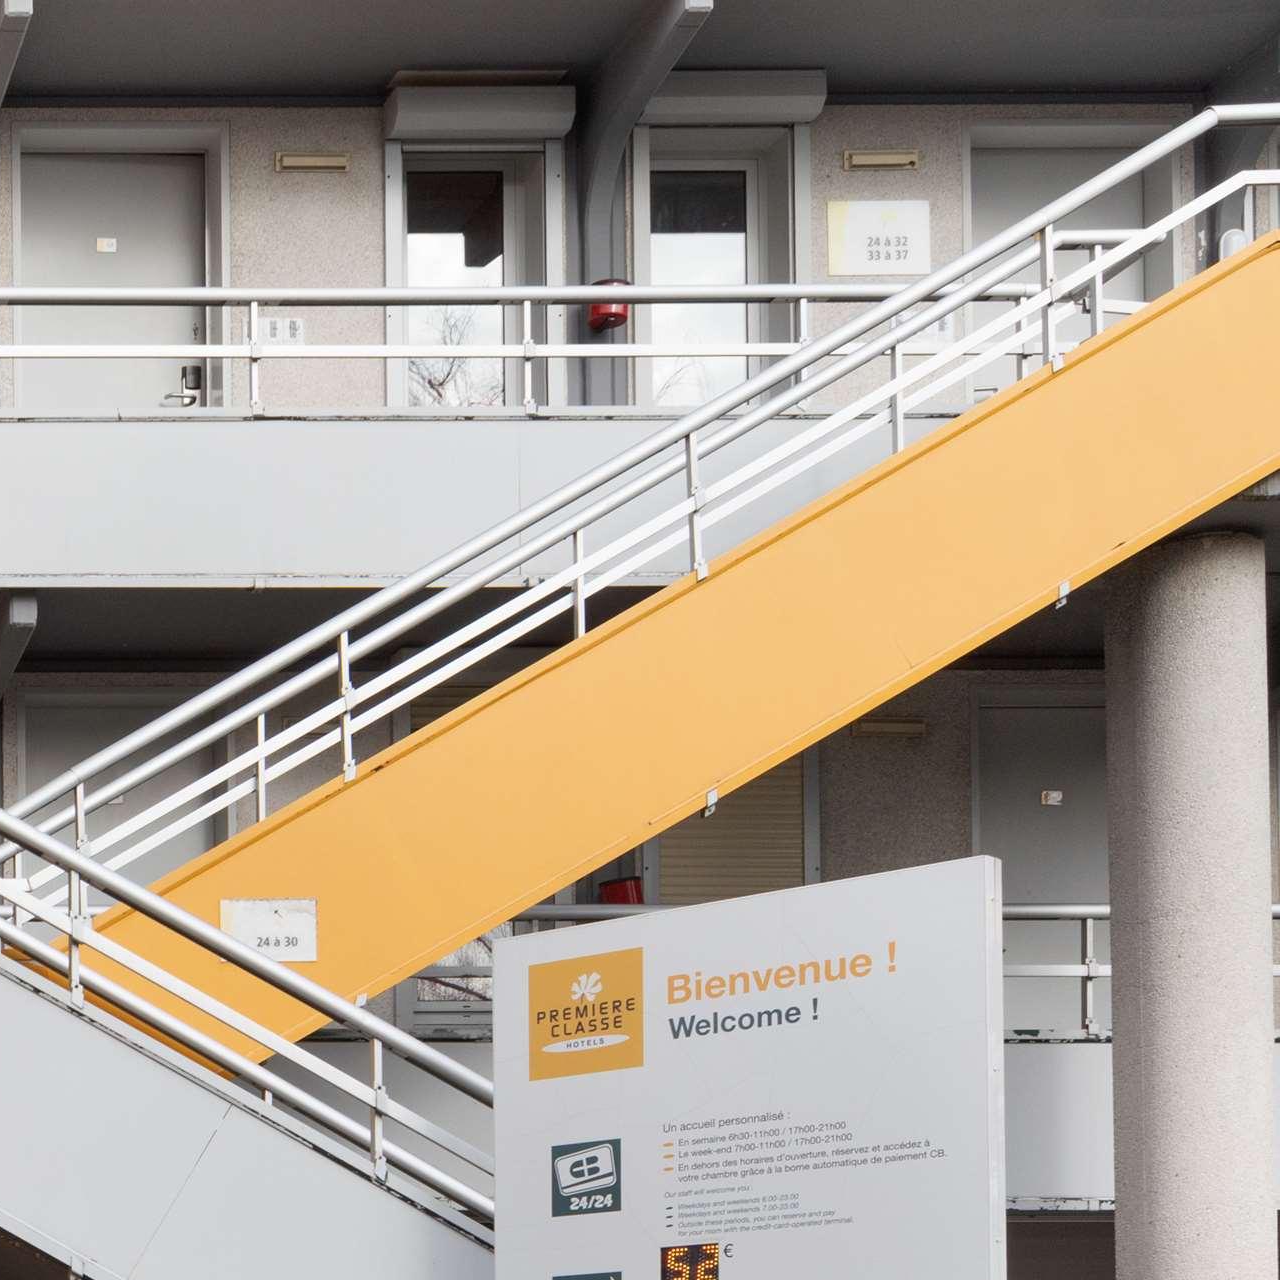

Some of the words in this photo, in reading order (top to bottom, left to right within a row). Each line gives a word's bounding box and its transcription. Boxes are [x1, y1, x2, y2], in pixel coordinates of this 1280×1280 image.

[867, 236, 881, 247] 24
[884, 236, 891, 247] à
[894, 235, 908, 247] 32
[867, 250, 881, 261] 33
[884, 250, 891, 261] à
[895, 249, 908, 261] 37
[257, 936, 270, 947] 24
[273, 936, 281, 947] à
[284, 936, 298, 947] 30
[667, 952, 873, 1005] Bienvenue
[888, 941, 896, 973] !
[536, 997, 636, 1025] PREMIERE
[668, 1005, 802, 1040] Welcome
[812, 997, 819, 1021] !
[551, 1015, 623, 1038] CLASSE
[566, 1037, 605, 1049] HOTELS
[663, 1122, 677, 1134] Un
[680, 1119, 715, 1132] accueil
[718, 1110, 784, 1128] personnalisé
[678, 1138, 690, 1146] En
[691, 1135, 726, 1145] semaine
[789, 1121, 846, 1135] 17h00-21h00
[678, 1150, 689, 1159] Le
[691, 1146, 732, 1157] week-end
[735, 1140, 786, 1152] 7h00-11h00
[795, 1132, 853, 1147] 17h00-21h00
[678, 1163, 690, 1172] En
[691, 1160, 720, 1171] dehors
[722, 1158, 737, 1167] des
[740, 1156, 774, 1166] horaires
[831, 1146, 869, 1157] réservez
[871, 1144, 881, 1153] et
[883, 1140, 921, 1151] accédez
[924, 1138, 931, 1147] à
[678, 1174, 699, 1183] votre
[701, 1170, 738, 1181] chambre
[740, 1167, 765, 1178] grâce
[766, 1166, 772, 1174] à
[775, 1164, 782, 1174] la
[784, 1161, 810, 1172] borne
[812, 1157, 868, 1170] automatique
[870, 1156, 882, 1164] de
[884, 1151, 927, 1164] paiement
[930, 1149, 948, 1159] CB.
[569, 1193, 613, 1211] 24/24
[724, 1243, 734, 1258] €
